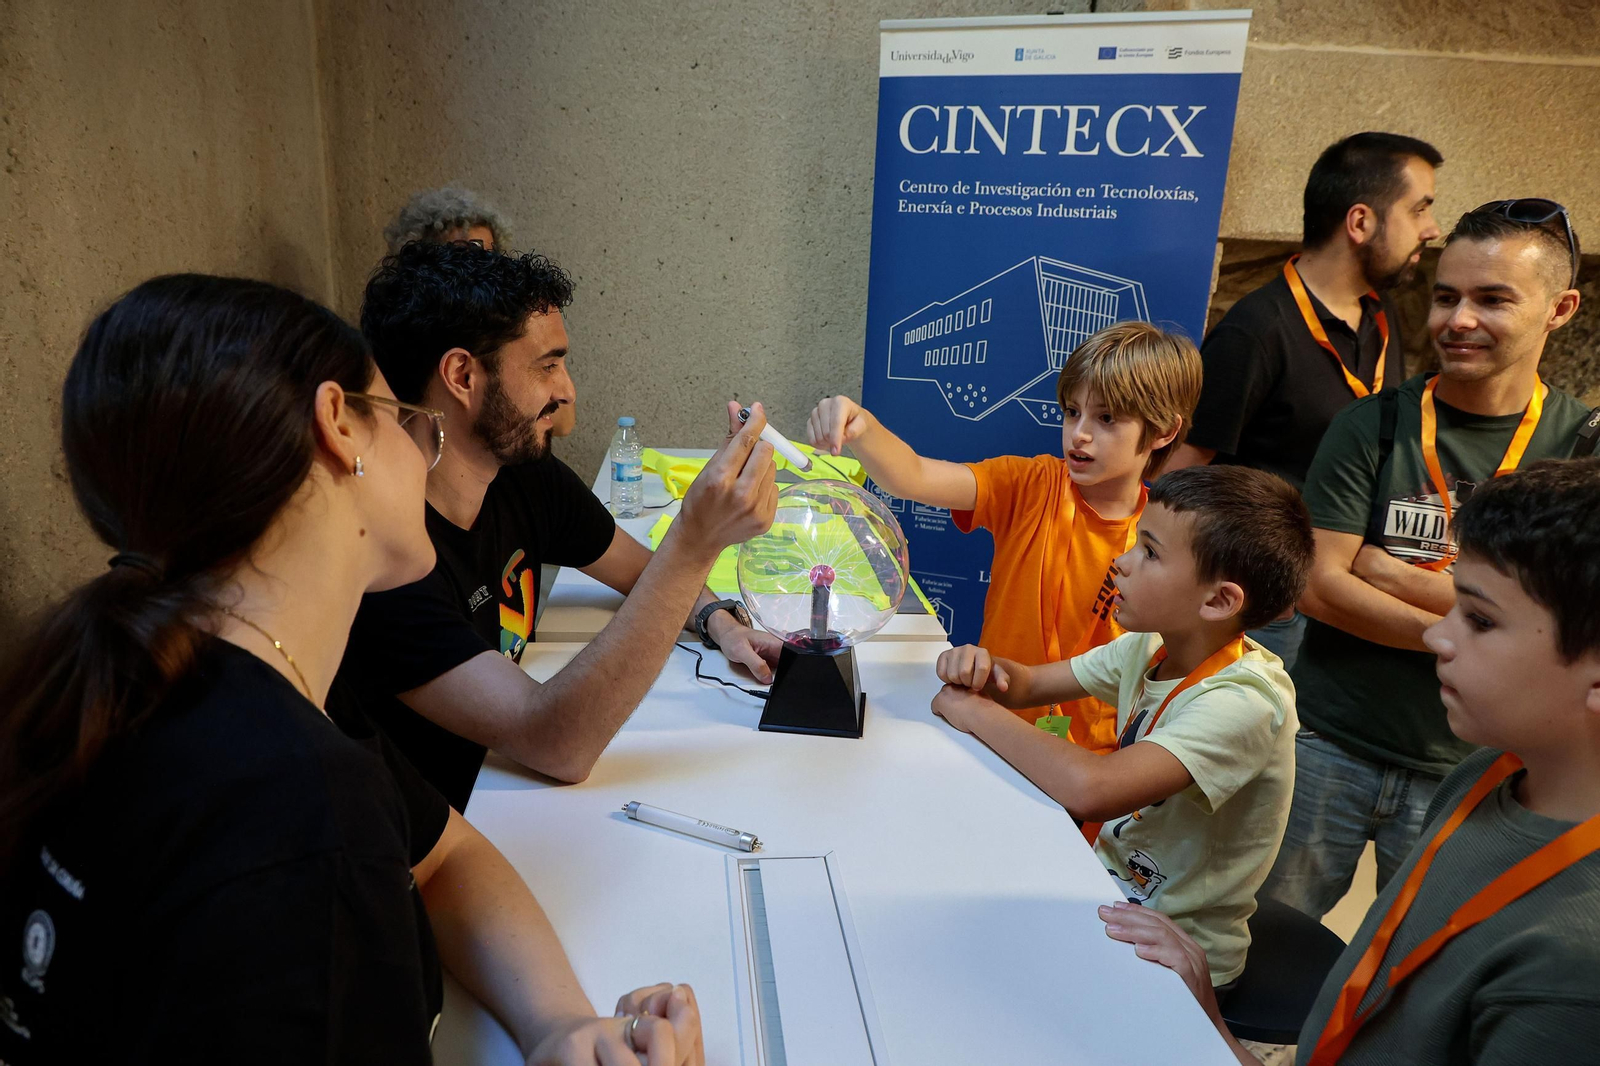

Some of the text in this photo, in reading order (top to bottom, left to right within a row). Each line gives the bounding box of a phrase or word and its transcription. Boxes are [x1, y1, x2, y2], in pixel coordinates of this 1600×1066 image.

[899, 104, 1207, 158] CINTECX
[899, 180, 1199, 203] Centro de Investigación en Tecnoloxías,
[898, 199, 1118, 220] Enerxía e Procesos Industriais
[914, 515, 948, 525] Fabricación
[919, 523, 946, 532] Materiais
[1394, 509, 1445, 540] WILD
[921, 578, 953, 588] Fabricación
